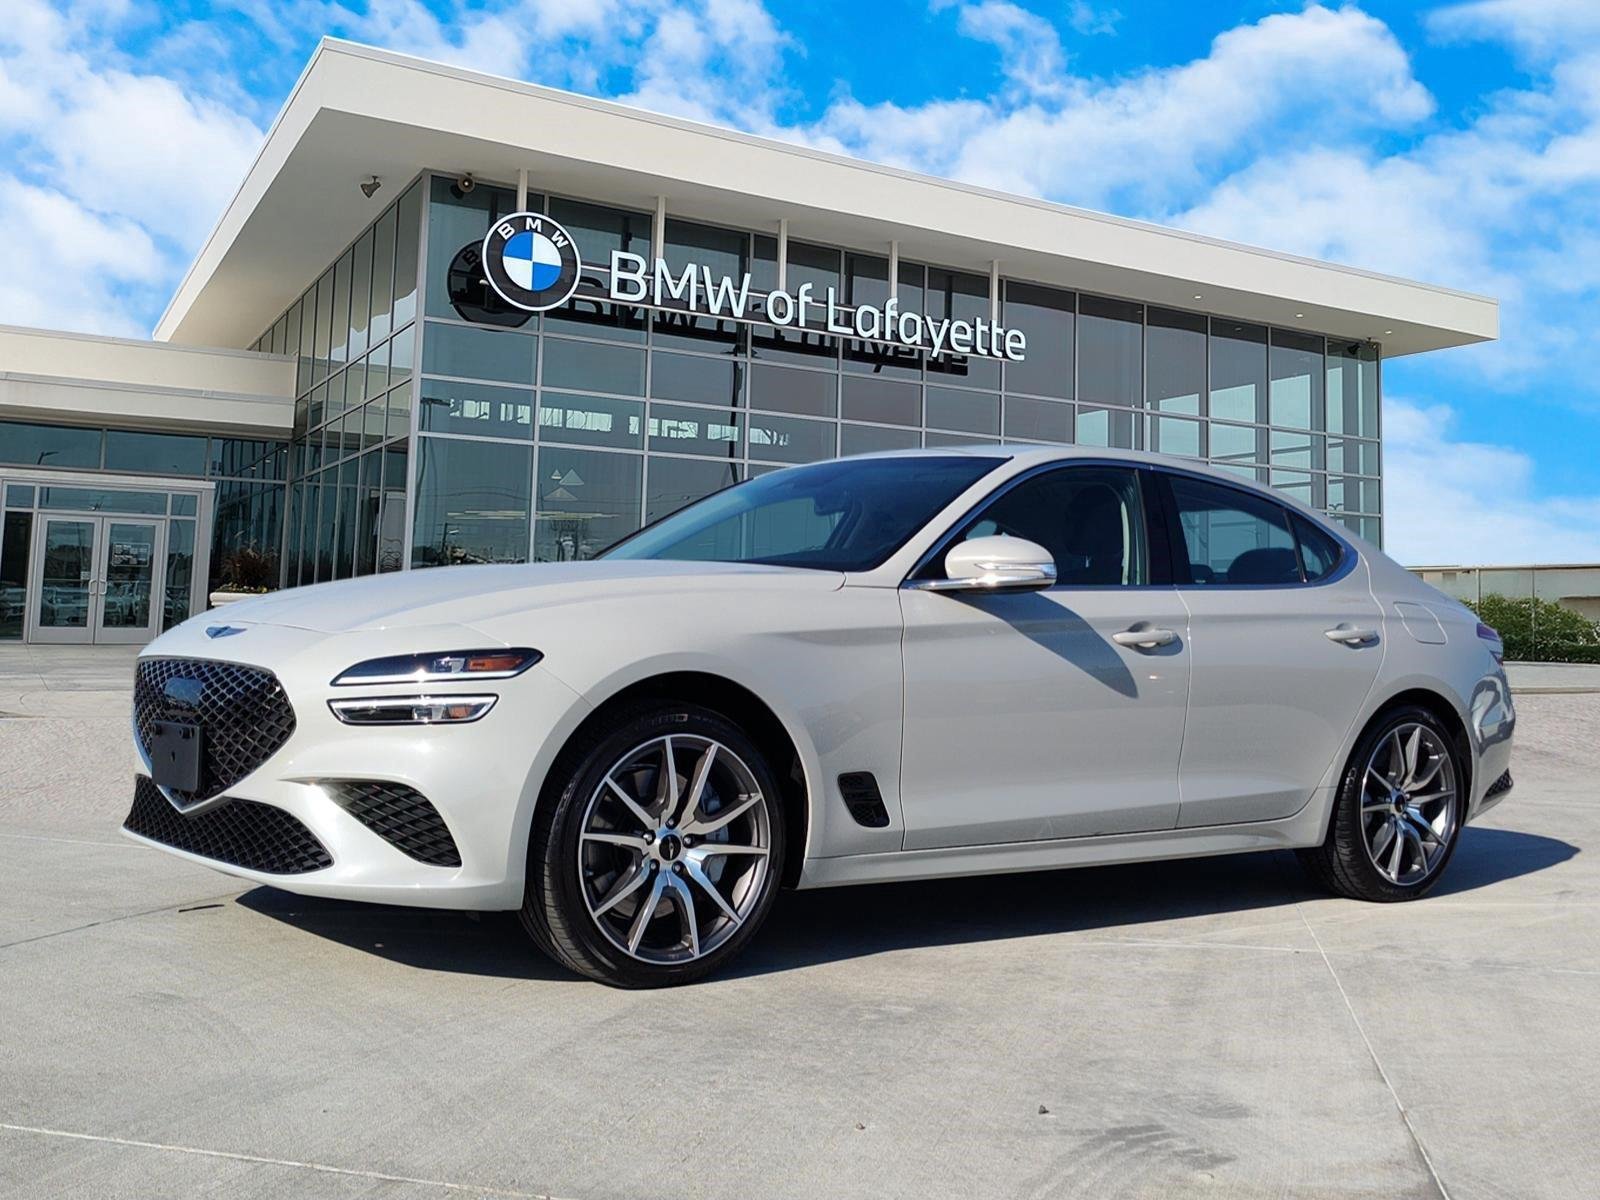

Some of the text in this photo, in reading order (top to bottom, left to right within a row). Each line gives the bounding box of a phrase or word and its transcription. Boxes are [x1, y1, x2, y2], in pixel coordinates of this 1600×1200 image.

[497, 217, 569, 248] BMW
[610, 250, 1026, 361] BMW of Lafayette
